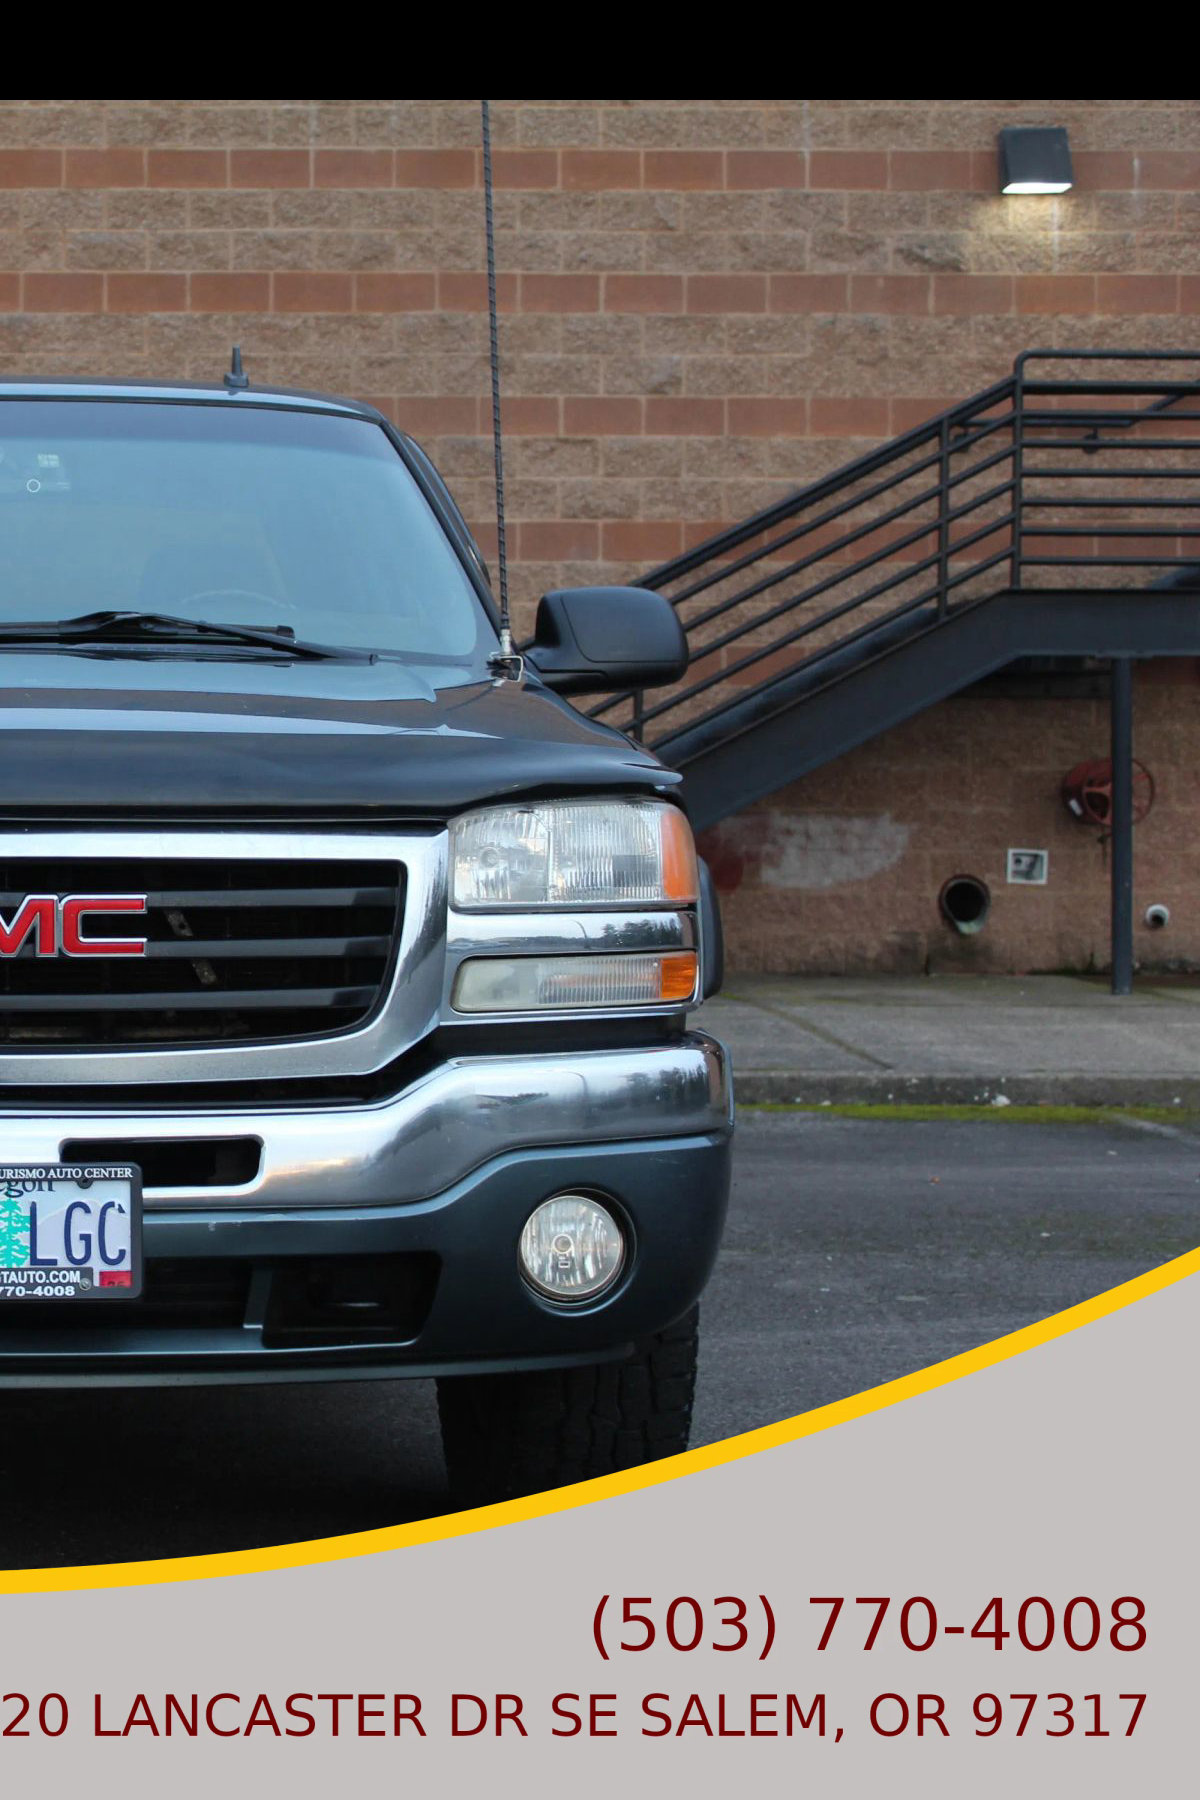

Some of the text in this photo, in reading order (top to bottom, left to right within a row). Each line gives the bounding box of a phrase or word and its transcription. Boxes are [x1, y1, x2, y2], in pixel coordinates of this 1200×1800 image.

[48, 1168, 82, 1179] AUTO
[84, 1167, 133, 1179] CENTER
[29, 1201, 126, 1266] LGC
